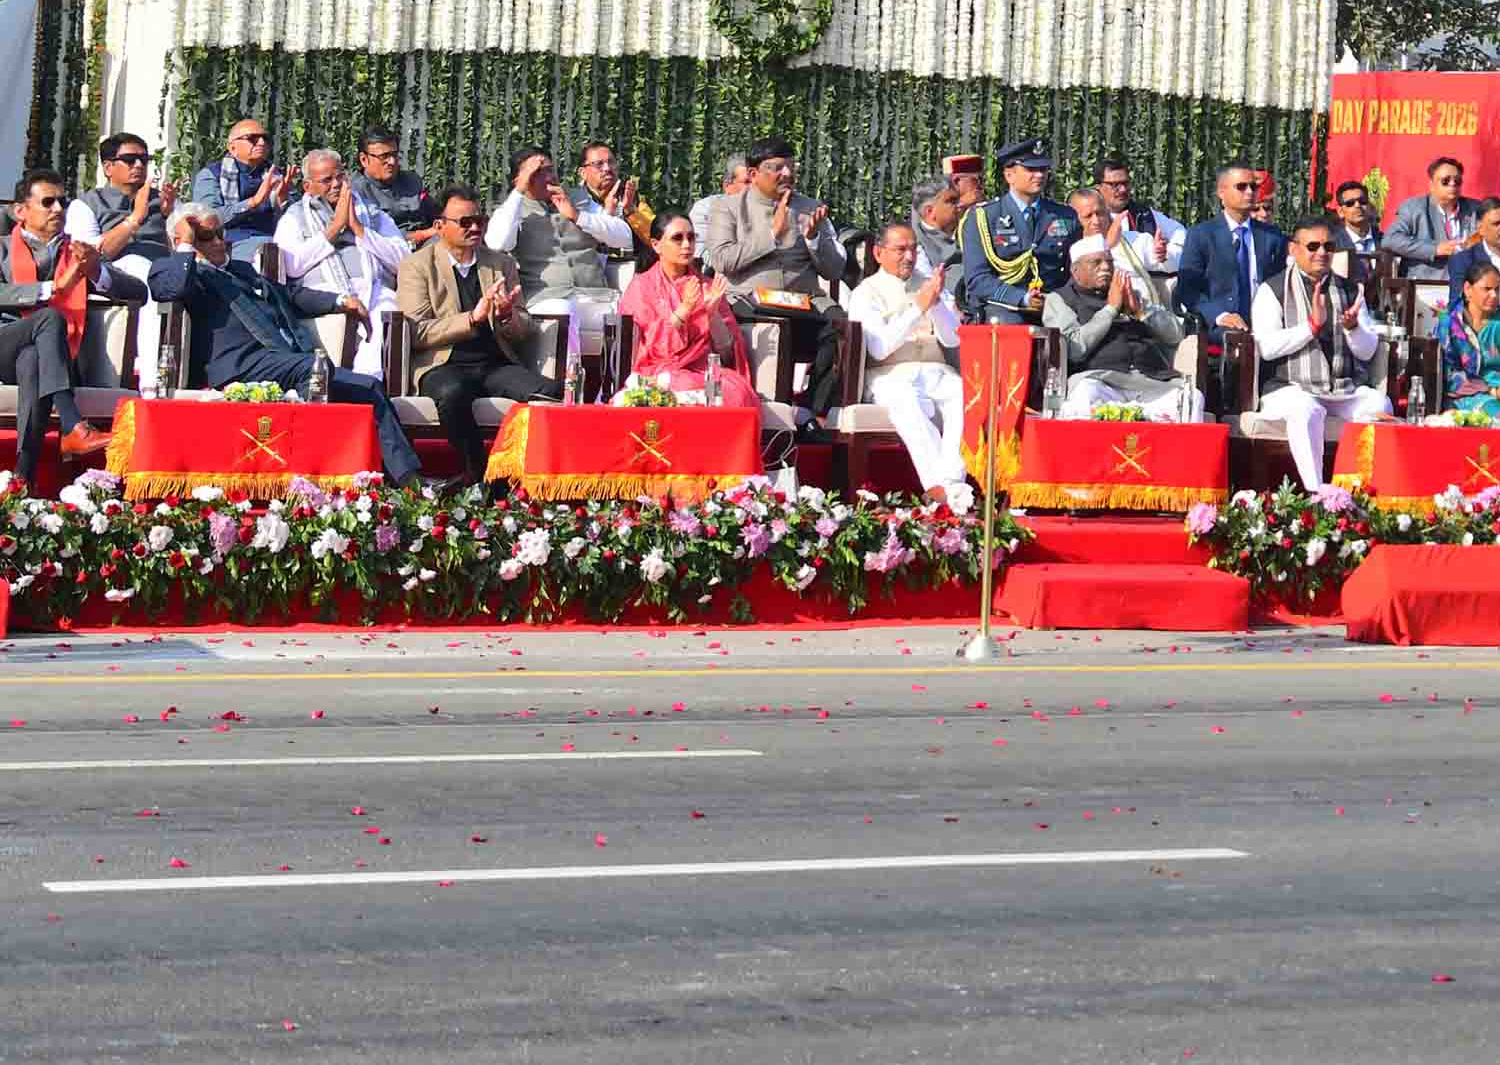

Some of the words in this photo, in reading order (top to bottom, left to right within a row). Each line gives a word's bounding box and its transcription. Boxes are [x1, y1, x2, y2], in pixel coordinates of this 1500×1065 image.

[1333, 99, 1364, 134] DAY
[1367, 99, 1433, 134] PARADE
[1437, 100, 1479, 135] 2026
